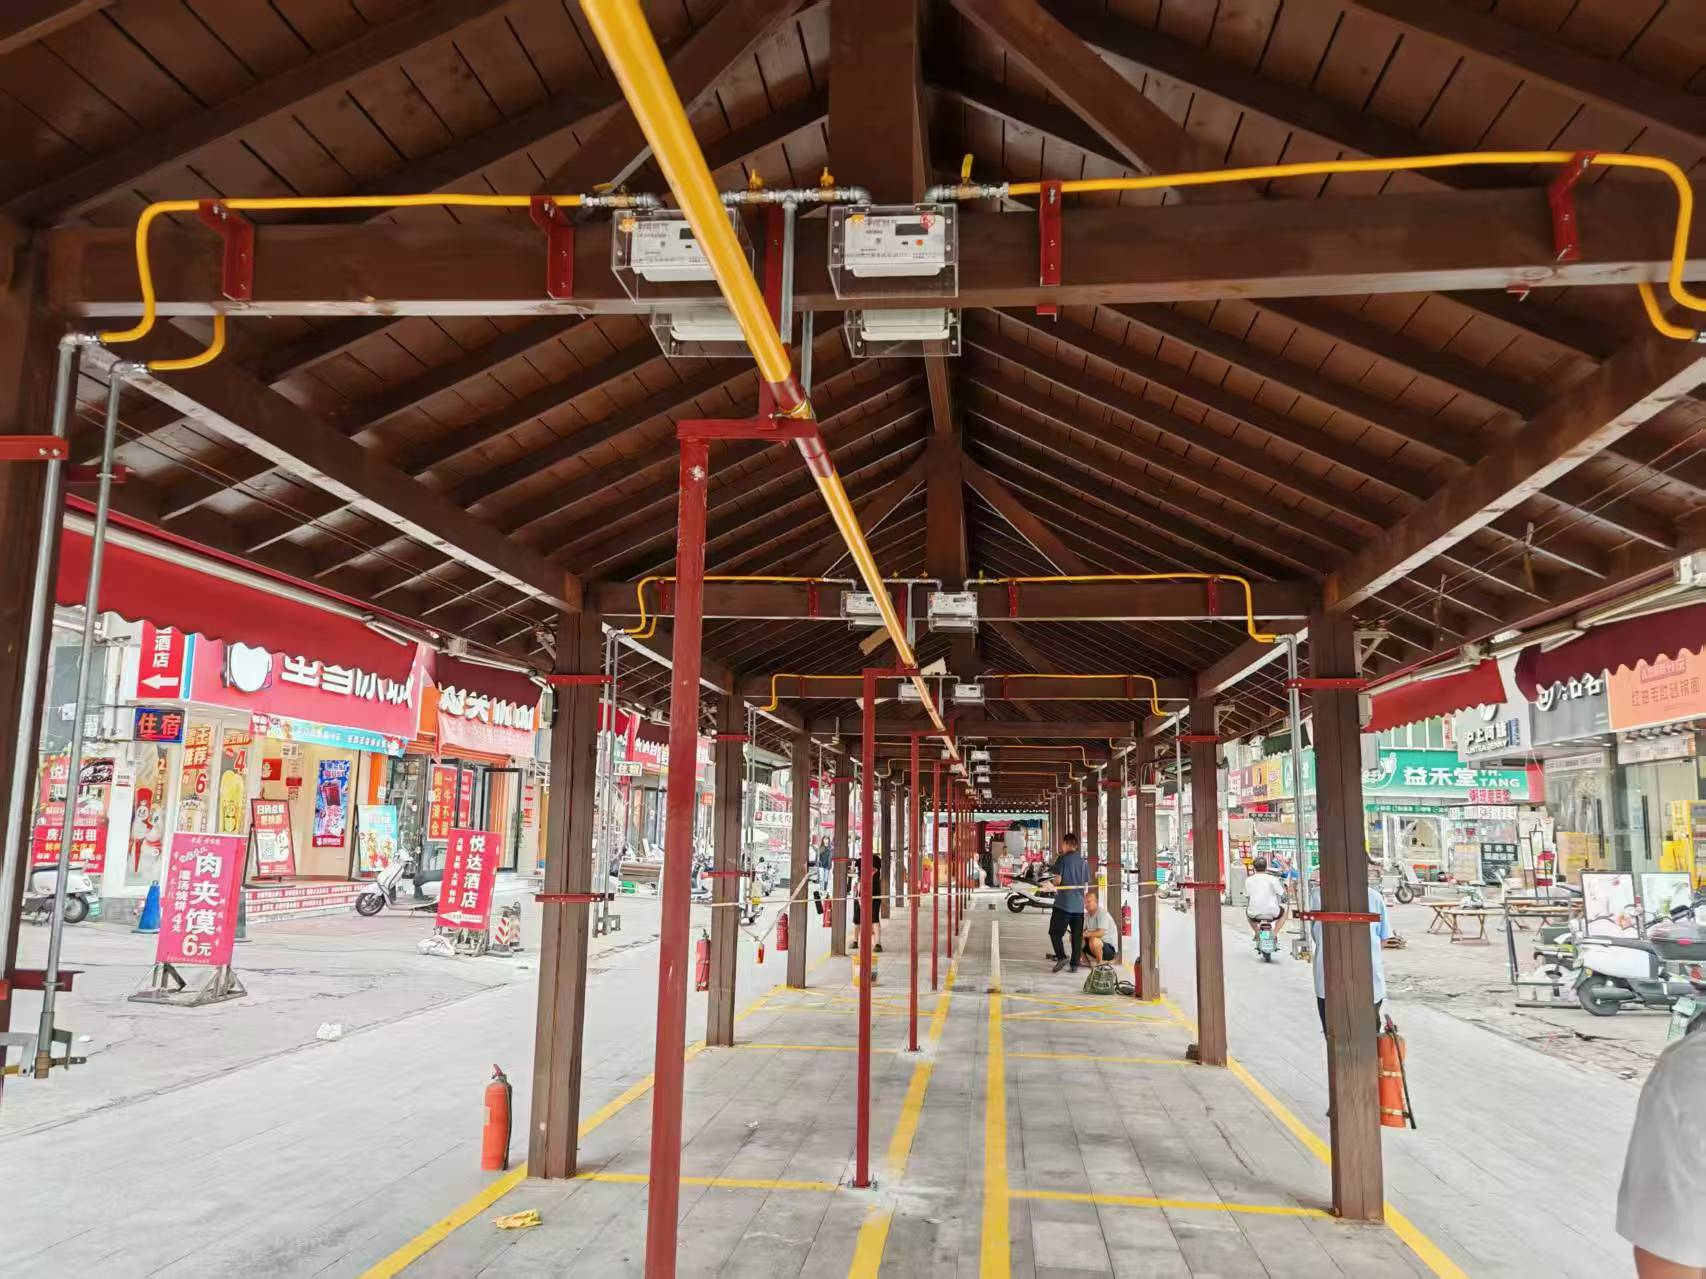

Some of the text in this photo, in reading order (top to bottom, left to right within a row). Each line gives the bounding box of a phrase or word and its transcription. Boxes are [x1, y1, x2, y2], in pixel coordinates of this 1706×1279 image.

[152, 627, 173, 668] 酒店
[137, 712, 181, 737] 住宿
[1403, 766, 1478, 787] 益禾堂
[1479, 778, 1520, 787] TANG
[46, 828, 97, 841] 房出租
[460, 835, 486, 908] 悦达酒店
[185, 852, 222, 935] 肉夹馍
[182, 934, 212, 956] 6元
